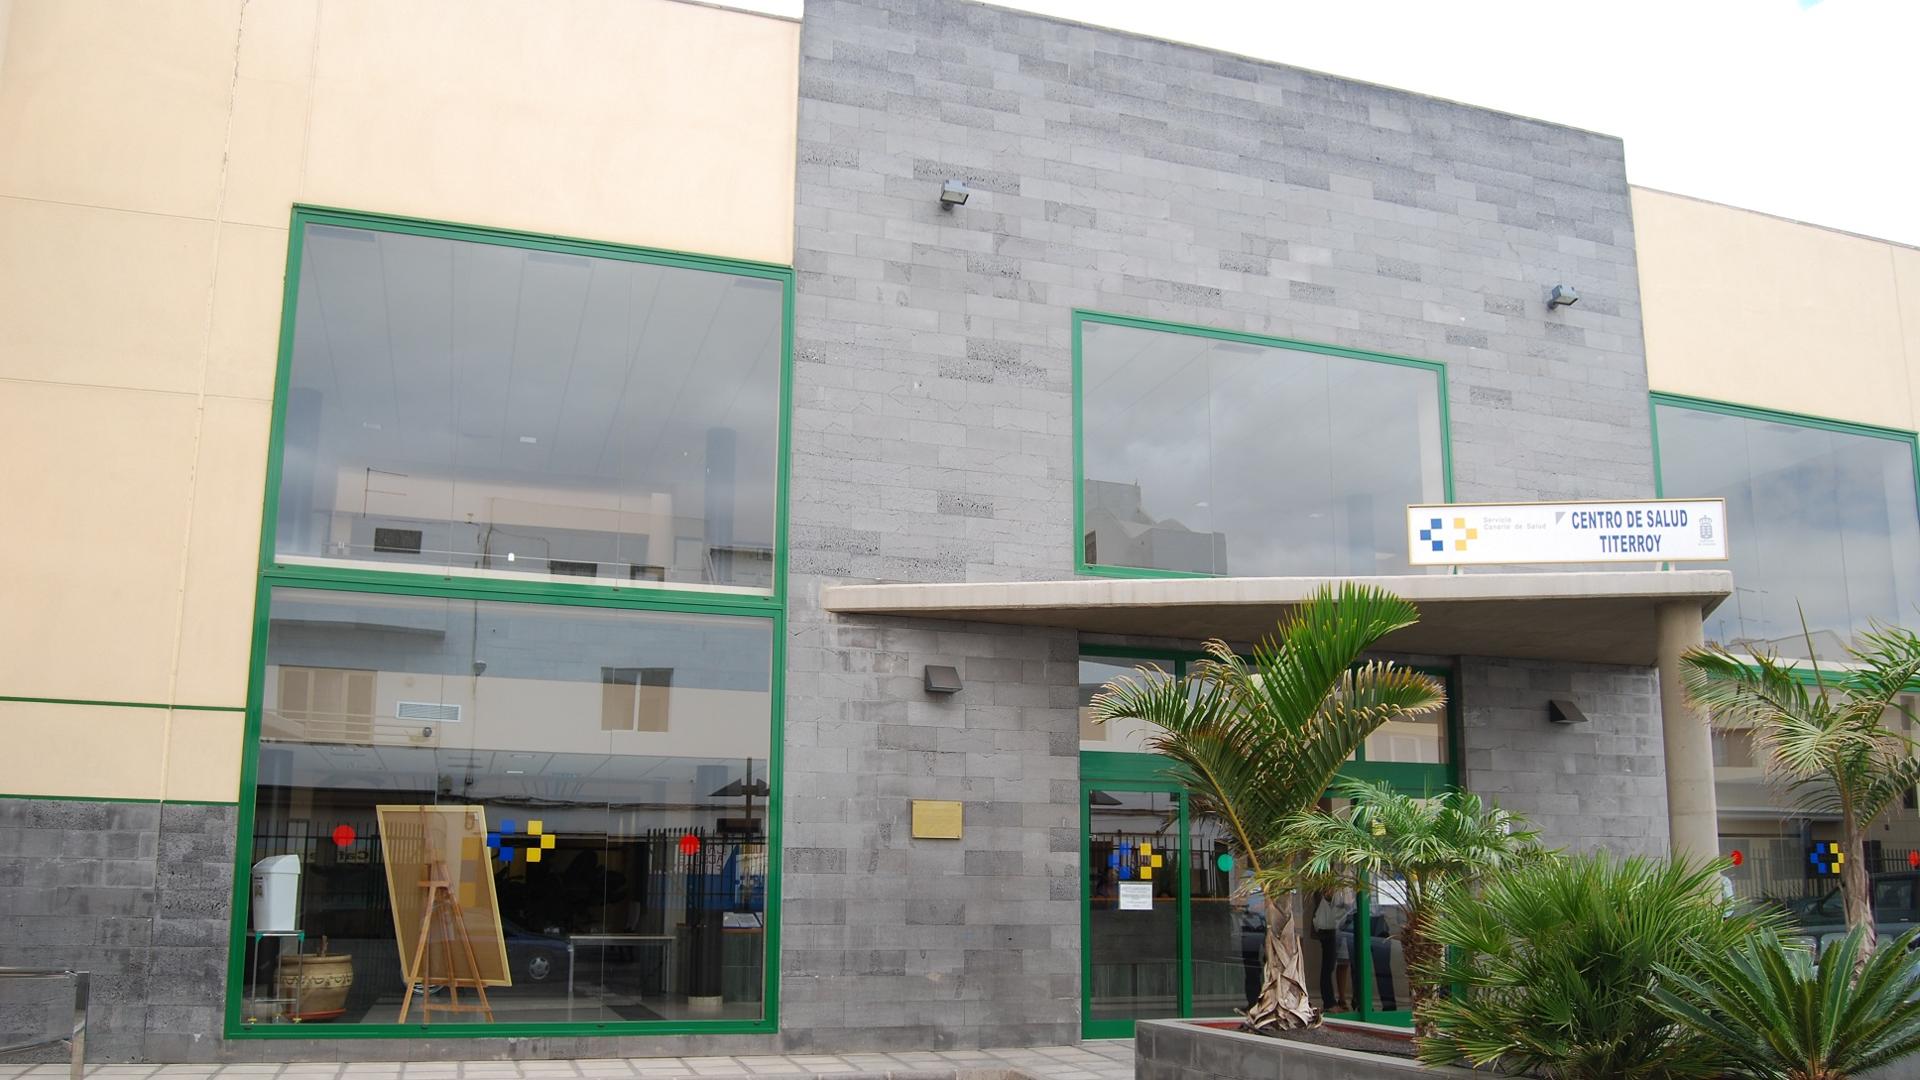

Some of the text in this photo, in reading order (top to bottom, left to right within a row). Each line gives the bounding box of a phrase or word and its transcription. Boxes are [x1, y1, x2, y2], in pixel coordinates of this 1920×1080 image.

[1572, 509, 1688, 529] CENTRO DE SALUD
[1600, 534, 1661, 552] TITERROY
